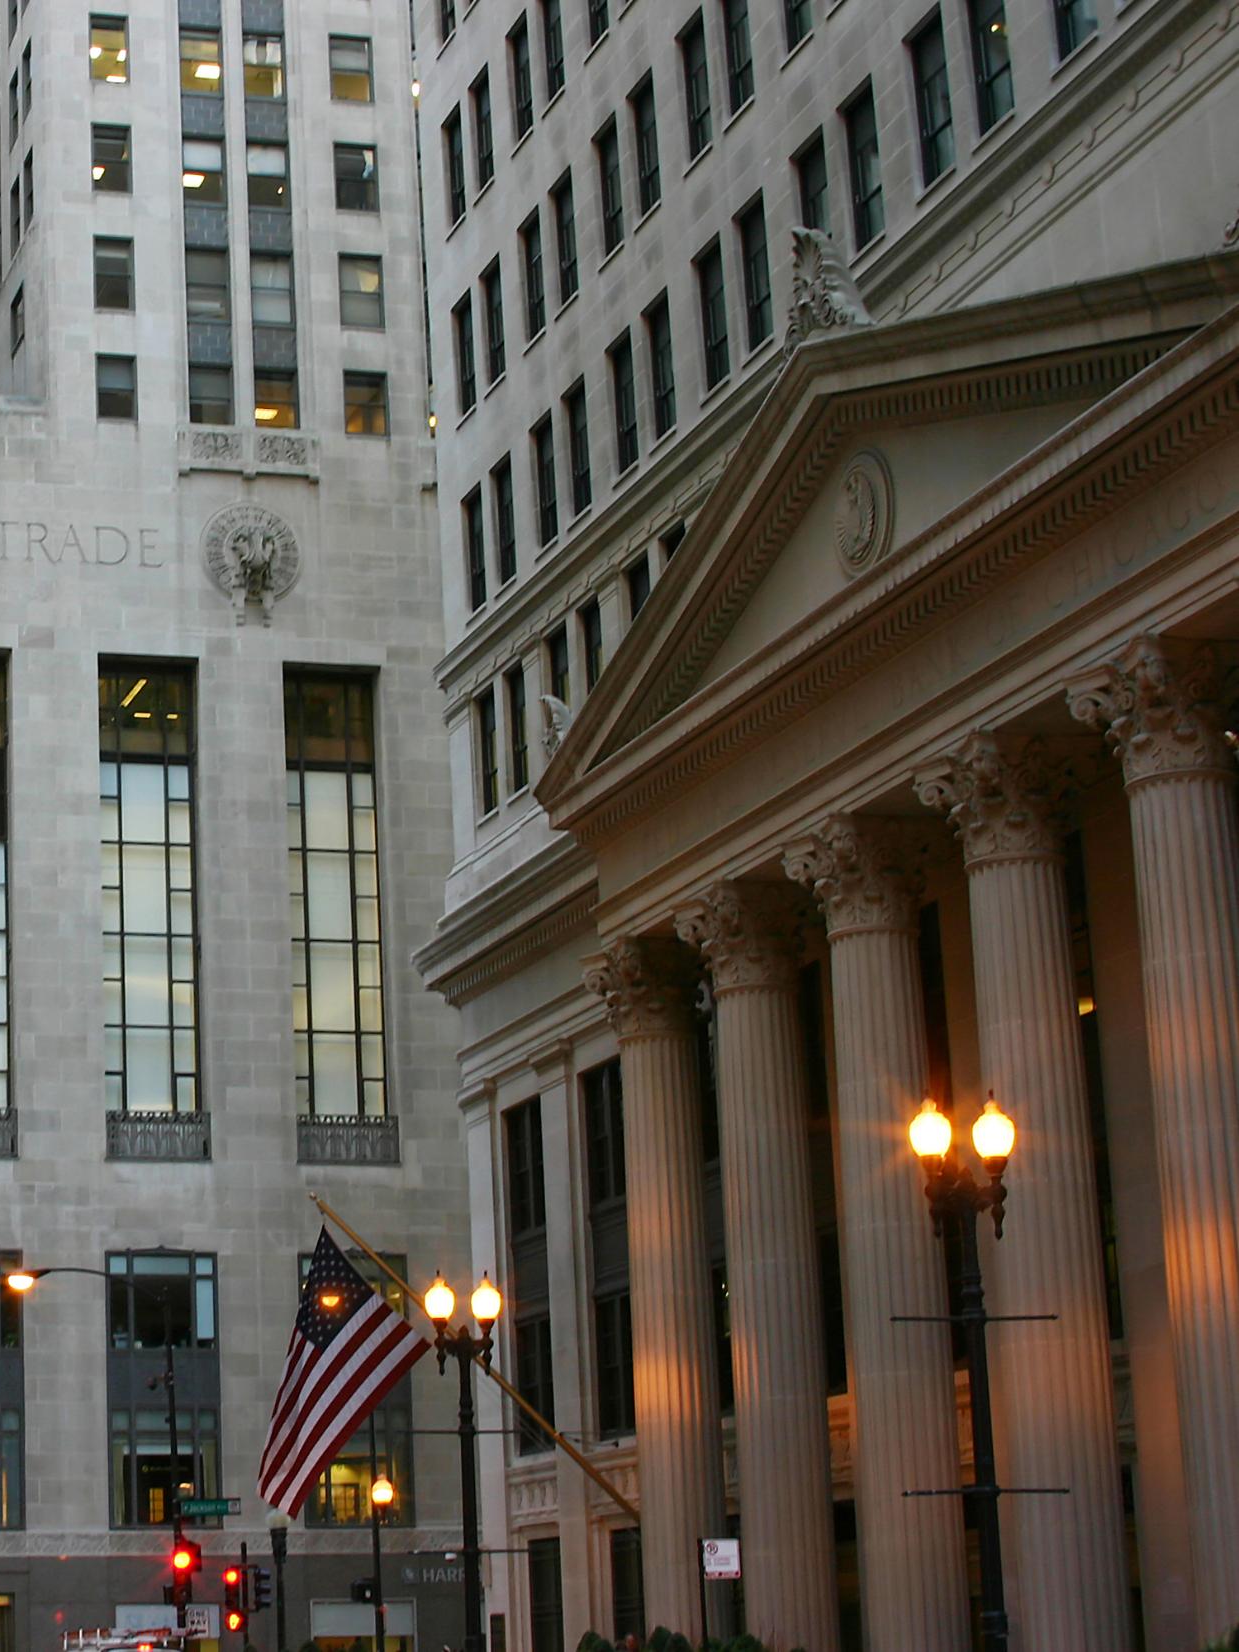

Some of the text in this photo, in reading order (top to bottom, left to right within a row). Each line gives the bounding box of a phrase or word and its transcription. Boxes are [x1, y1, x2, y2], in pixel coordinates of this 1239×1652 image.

[1044, 469, 1221, 608] CHICAGO
[190, 1609, 206, 1617] ONE
[190, 1619, 207, 1627] WAY
